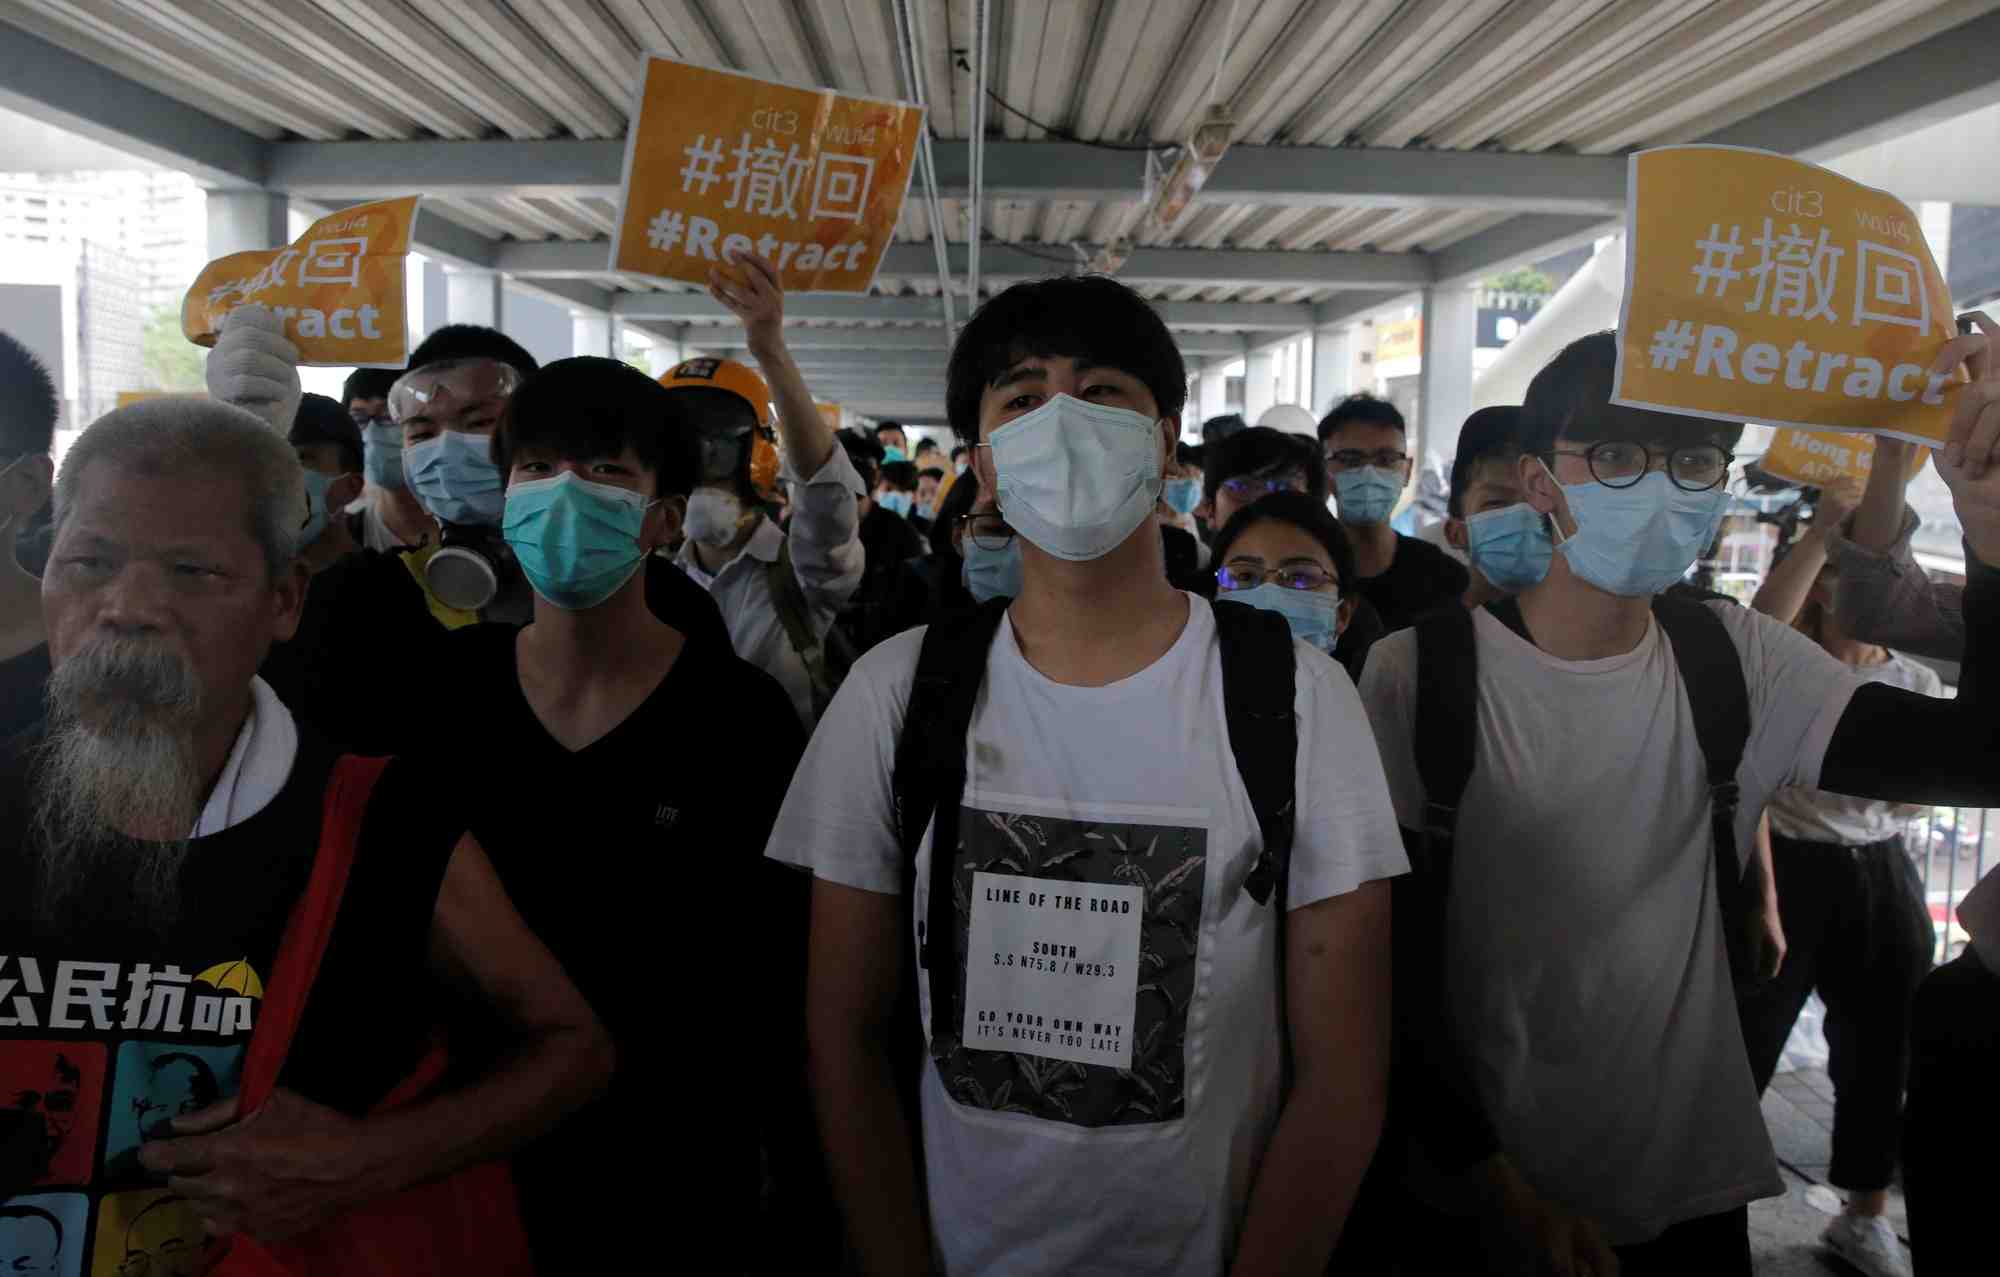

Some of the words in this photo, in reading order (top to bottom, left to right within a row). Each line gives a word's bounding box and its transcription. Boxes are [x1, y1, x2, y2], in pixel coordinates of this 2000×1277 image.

[752, 106, 800, 135] cit3
[824, 124, 876, 146] wui4
[680, 131, 877, 224] #撤回
[1769, 184, 1825, 218] cit3
[647, 207, 867, 274] #Retract
[1692, 216, 1932, 337] #撤回
[1648, 318, 1955, 405] #Retract
[986, 887, 1021, 904] LINE
[1028, 892, 1046, 908] OF
[1055, 895, 1082, 911] THE
[1090, 898, 1130, 914] ROAD
[993, 953, 1014, 966] S.S
[1020, 955, 1057, 973] N75.8
[1075, 963, 1115, 978] W29.3
[1033, 941, 1077, 959] SOUTH
[977, 1025, 1004, 1037] IT'S
[1012, 1027, 1050, 1044] NEVER
[1060, 1034, 1082, 1048] TOO
[1091, 1038, 1120, 1053] LATE
[978, 1010, 996, 1022] GO
[1006, 1012, 1043, 1027] YOUR
[1053, 1018, 1083, 1033] OWN
[1094, 1023, 1121, 1037] WAY
